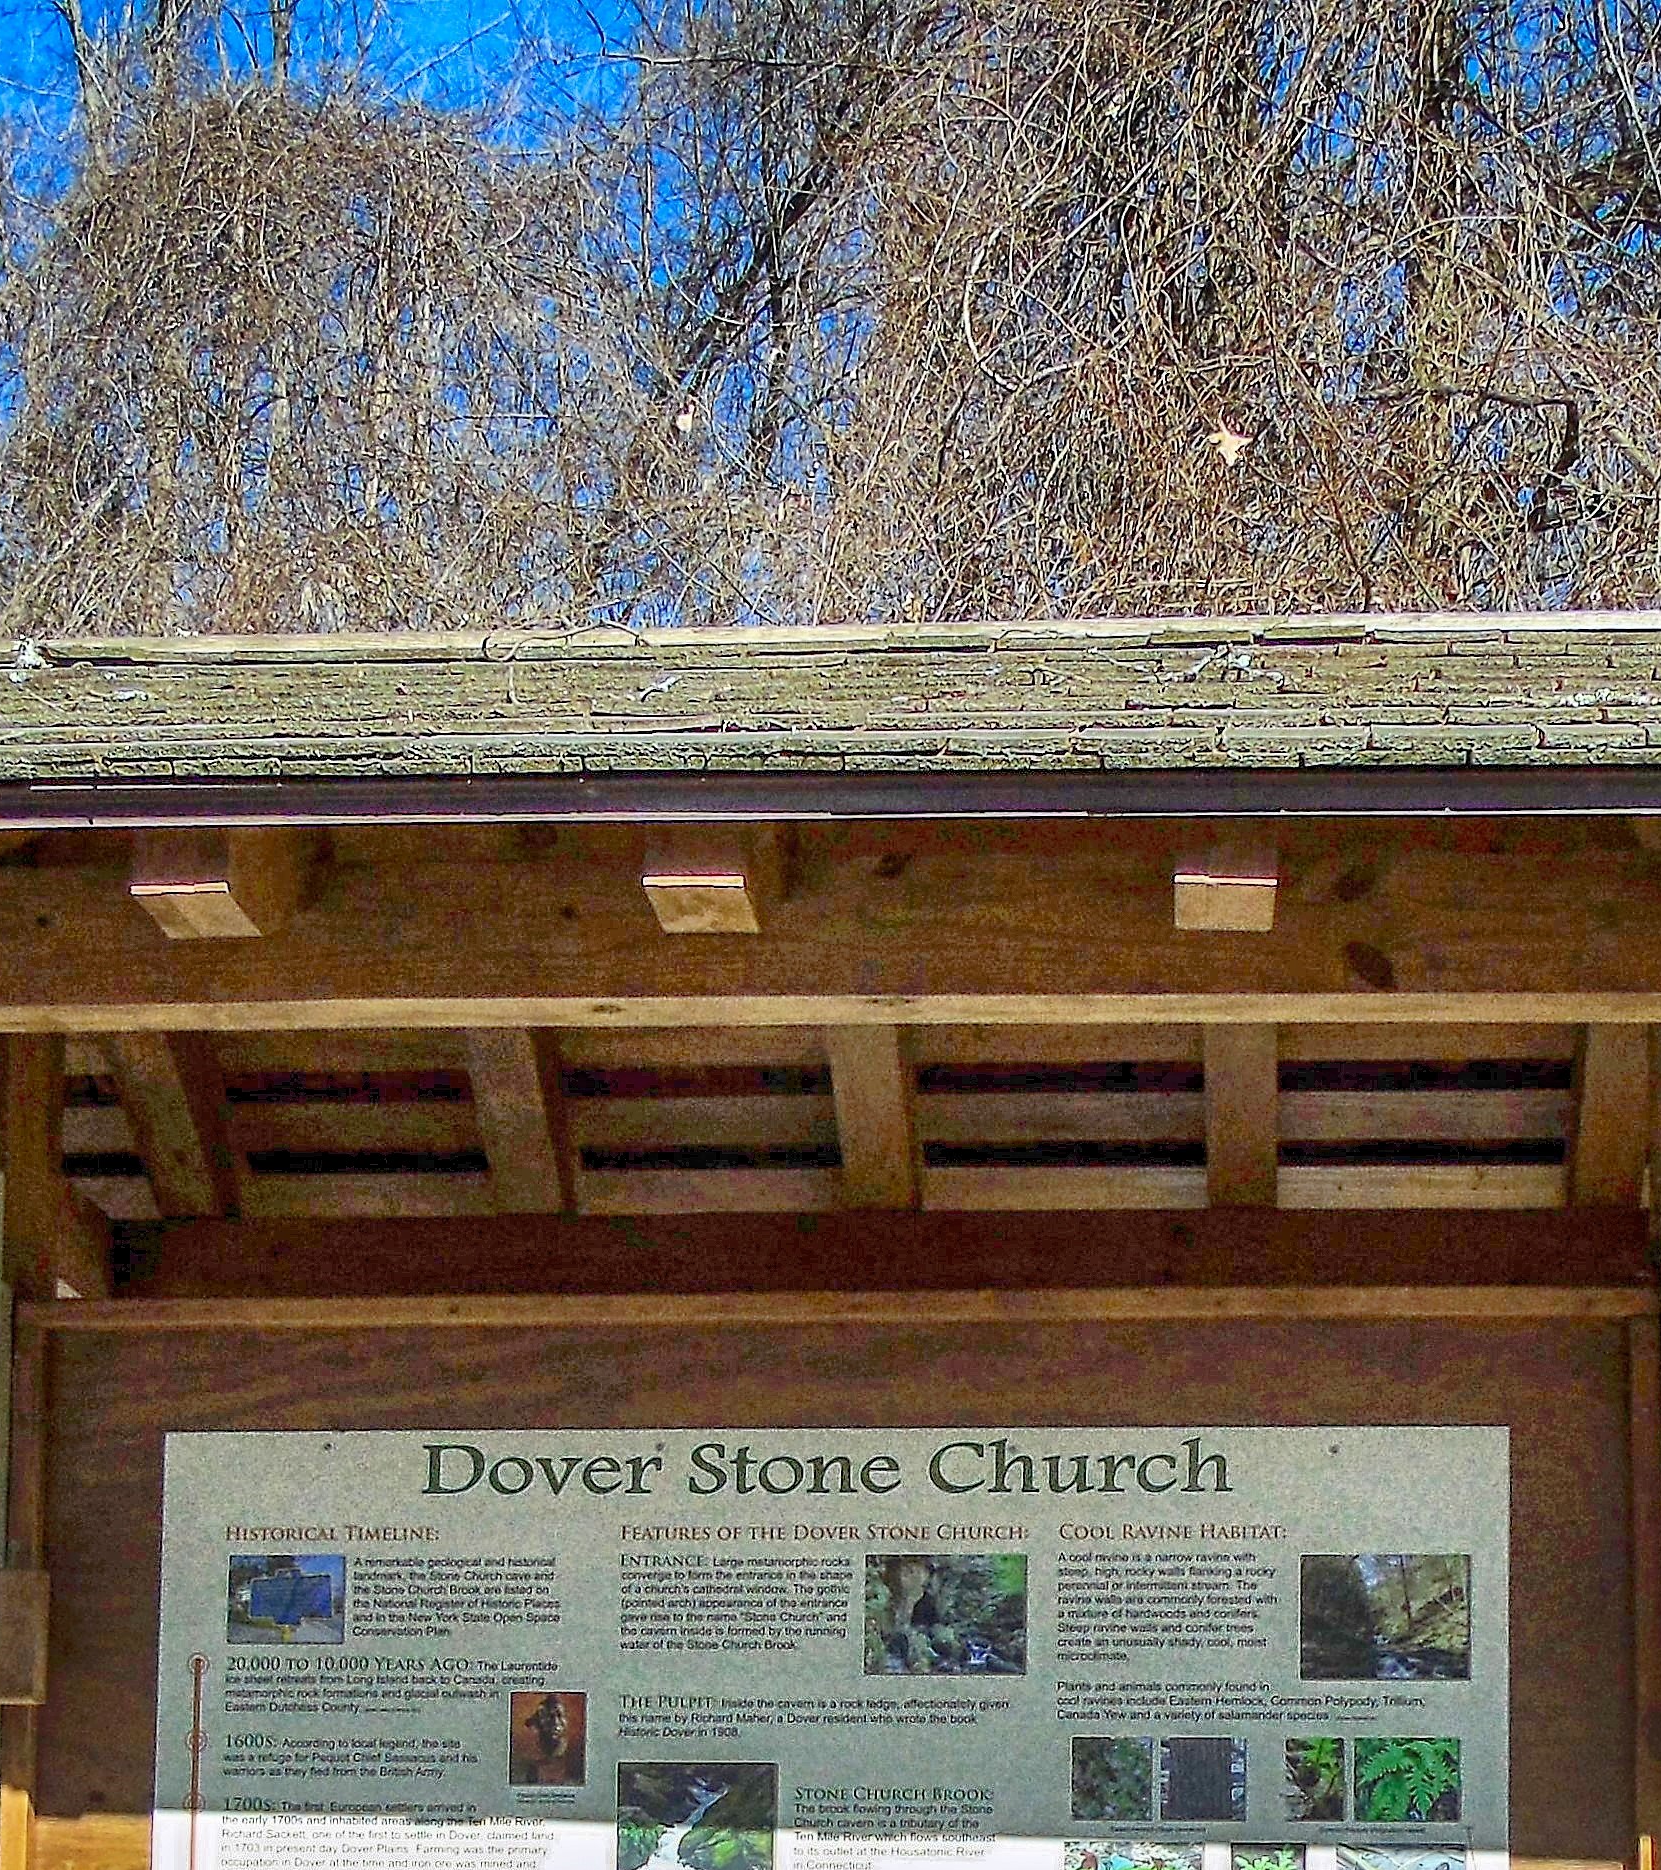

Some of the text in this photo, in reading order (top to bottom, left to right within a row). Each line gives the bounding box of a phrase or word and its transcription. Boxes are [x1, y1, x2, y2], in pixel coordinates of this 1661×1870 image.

[422, 1439, 1232, 1495] Dover Stone Church
[226, 1525, 440, 1541] HISTORICAL TIMELINE:
[620, 1523, 1030, 1540] FEATURES OF THE DOVER STONE CHURCH:
[1058, 1523, 1288, 1539] COOL RAVINE HABITAT:
[620, 1694, 652, 1709] THE
[794, 1786, 850, 1801] STONE
[854, 1786, 926, 1801] CHURCH
[794, 1804, 994, 1817] The brook flowing through the Stone
[222, 1815, 238, 1826] the
[242, 1815, 268, 1829] early
[272, 1815, 304, 1826] 1700s
[306, 1815, 326, 1826] and
[330, 1815, 378, 1826] inhabited
[382, 1818, 412, 1826] areas
[414, 1815, 444, 1829] along
[446, 1815, 464, 1827] the
[466, 1815, 486, 1827] Ten
[490, 1815, 512, 1827] Mile
[794, 1817, 980, 1830] Church cavern is a tributary of the
[794, 1832, 998, 1842] Ten Mile River which flows southeast
